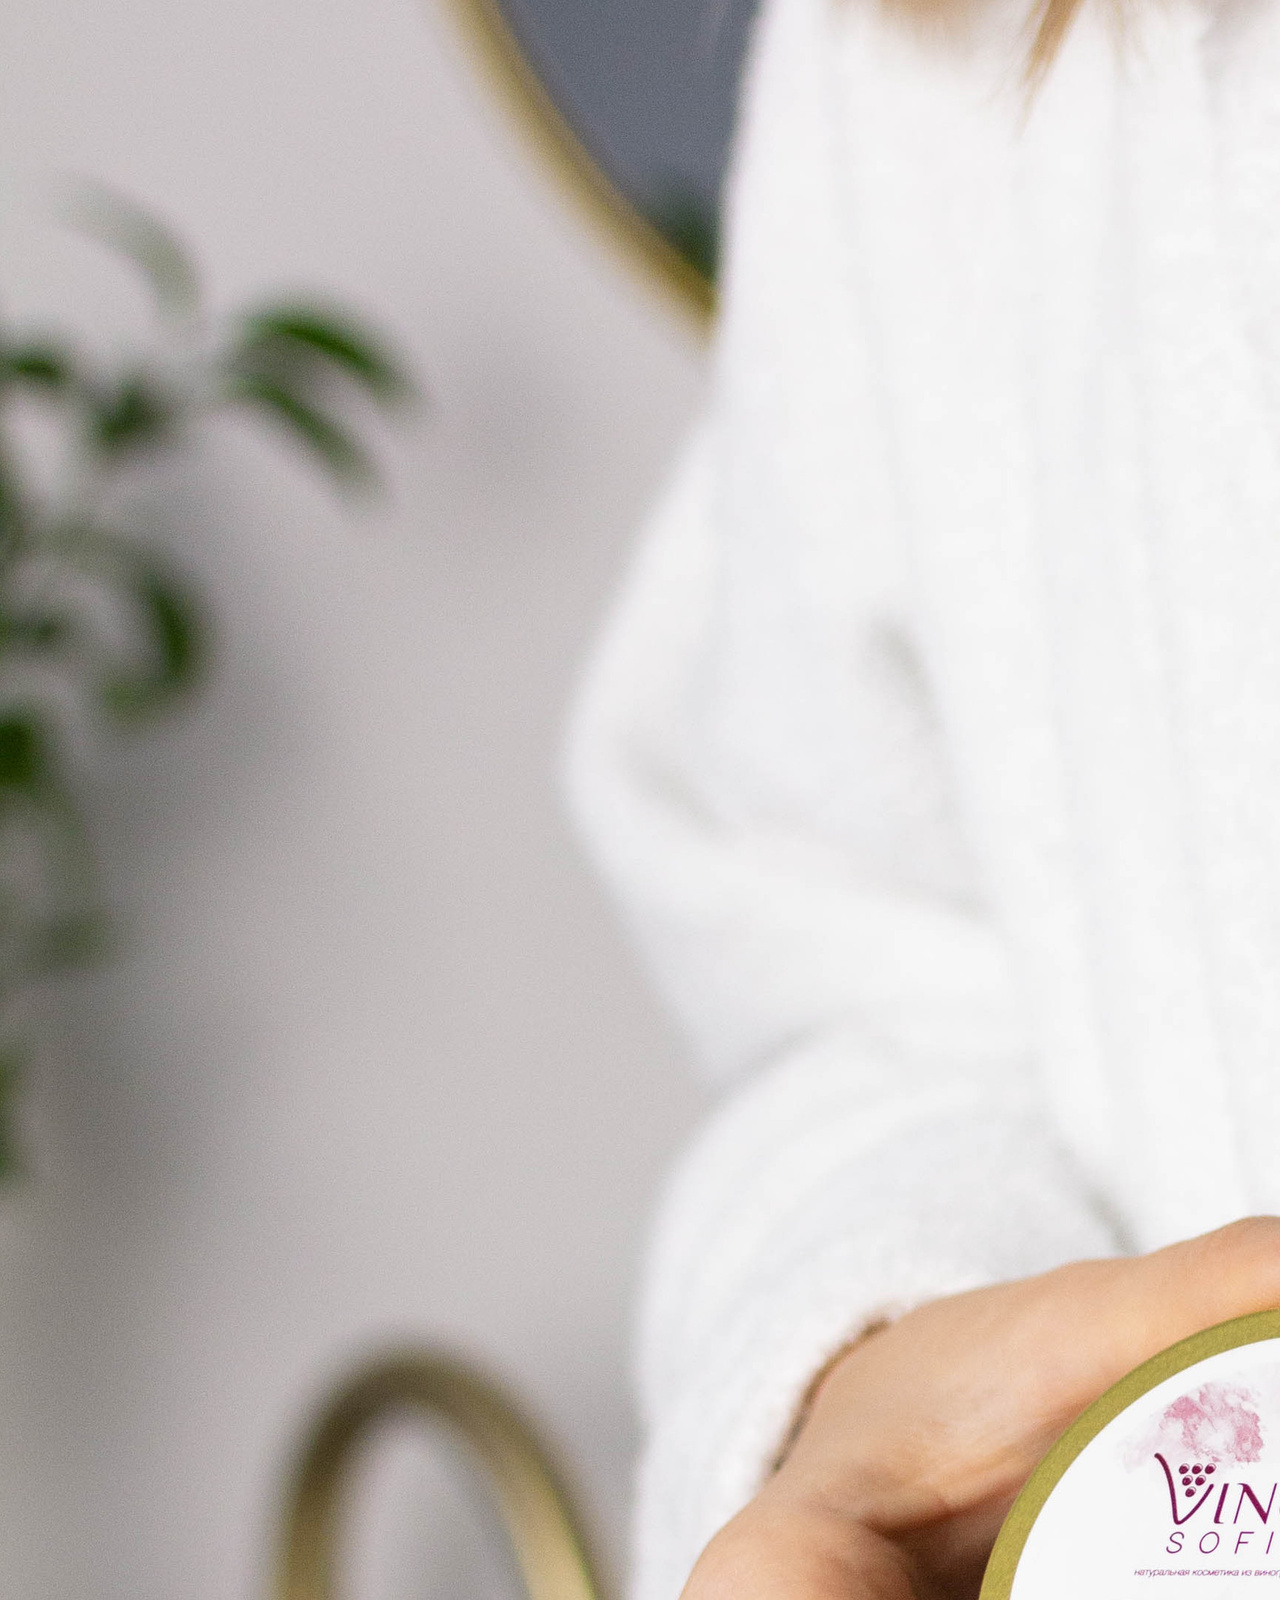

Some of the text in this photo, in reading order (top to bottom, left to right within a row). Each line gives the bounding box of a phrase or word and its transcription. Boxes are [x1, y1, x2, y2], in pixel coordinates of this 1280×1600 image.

[1134, 1568, 1190, 1577] натуральная
[1192, 1568, 1239, 1577] косметика
[1241, 1569, 1252, 1577] из
